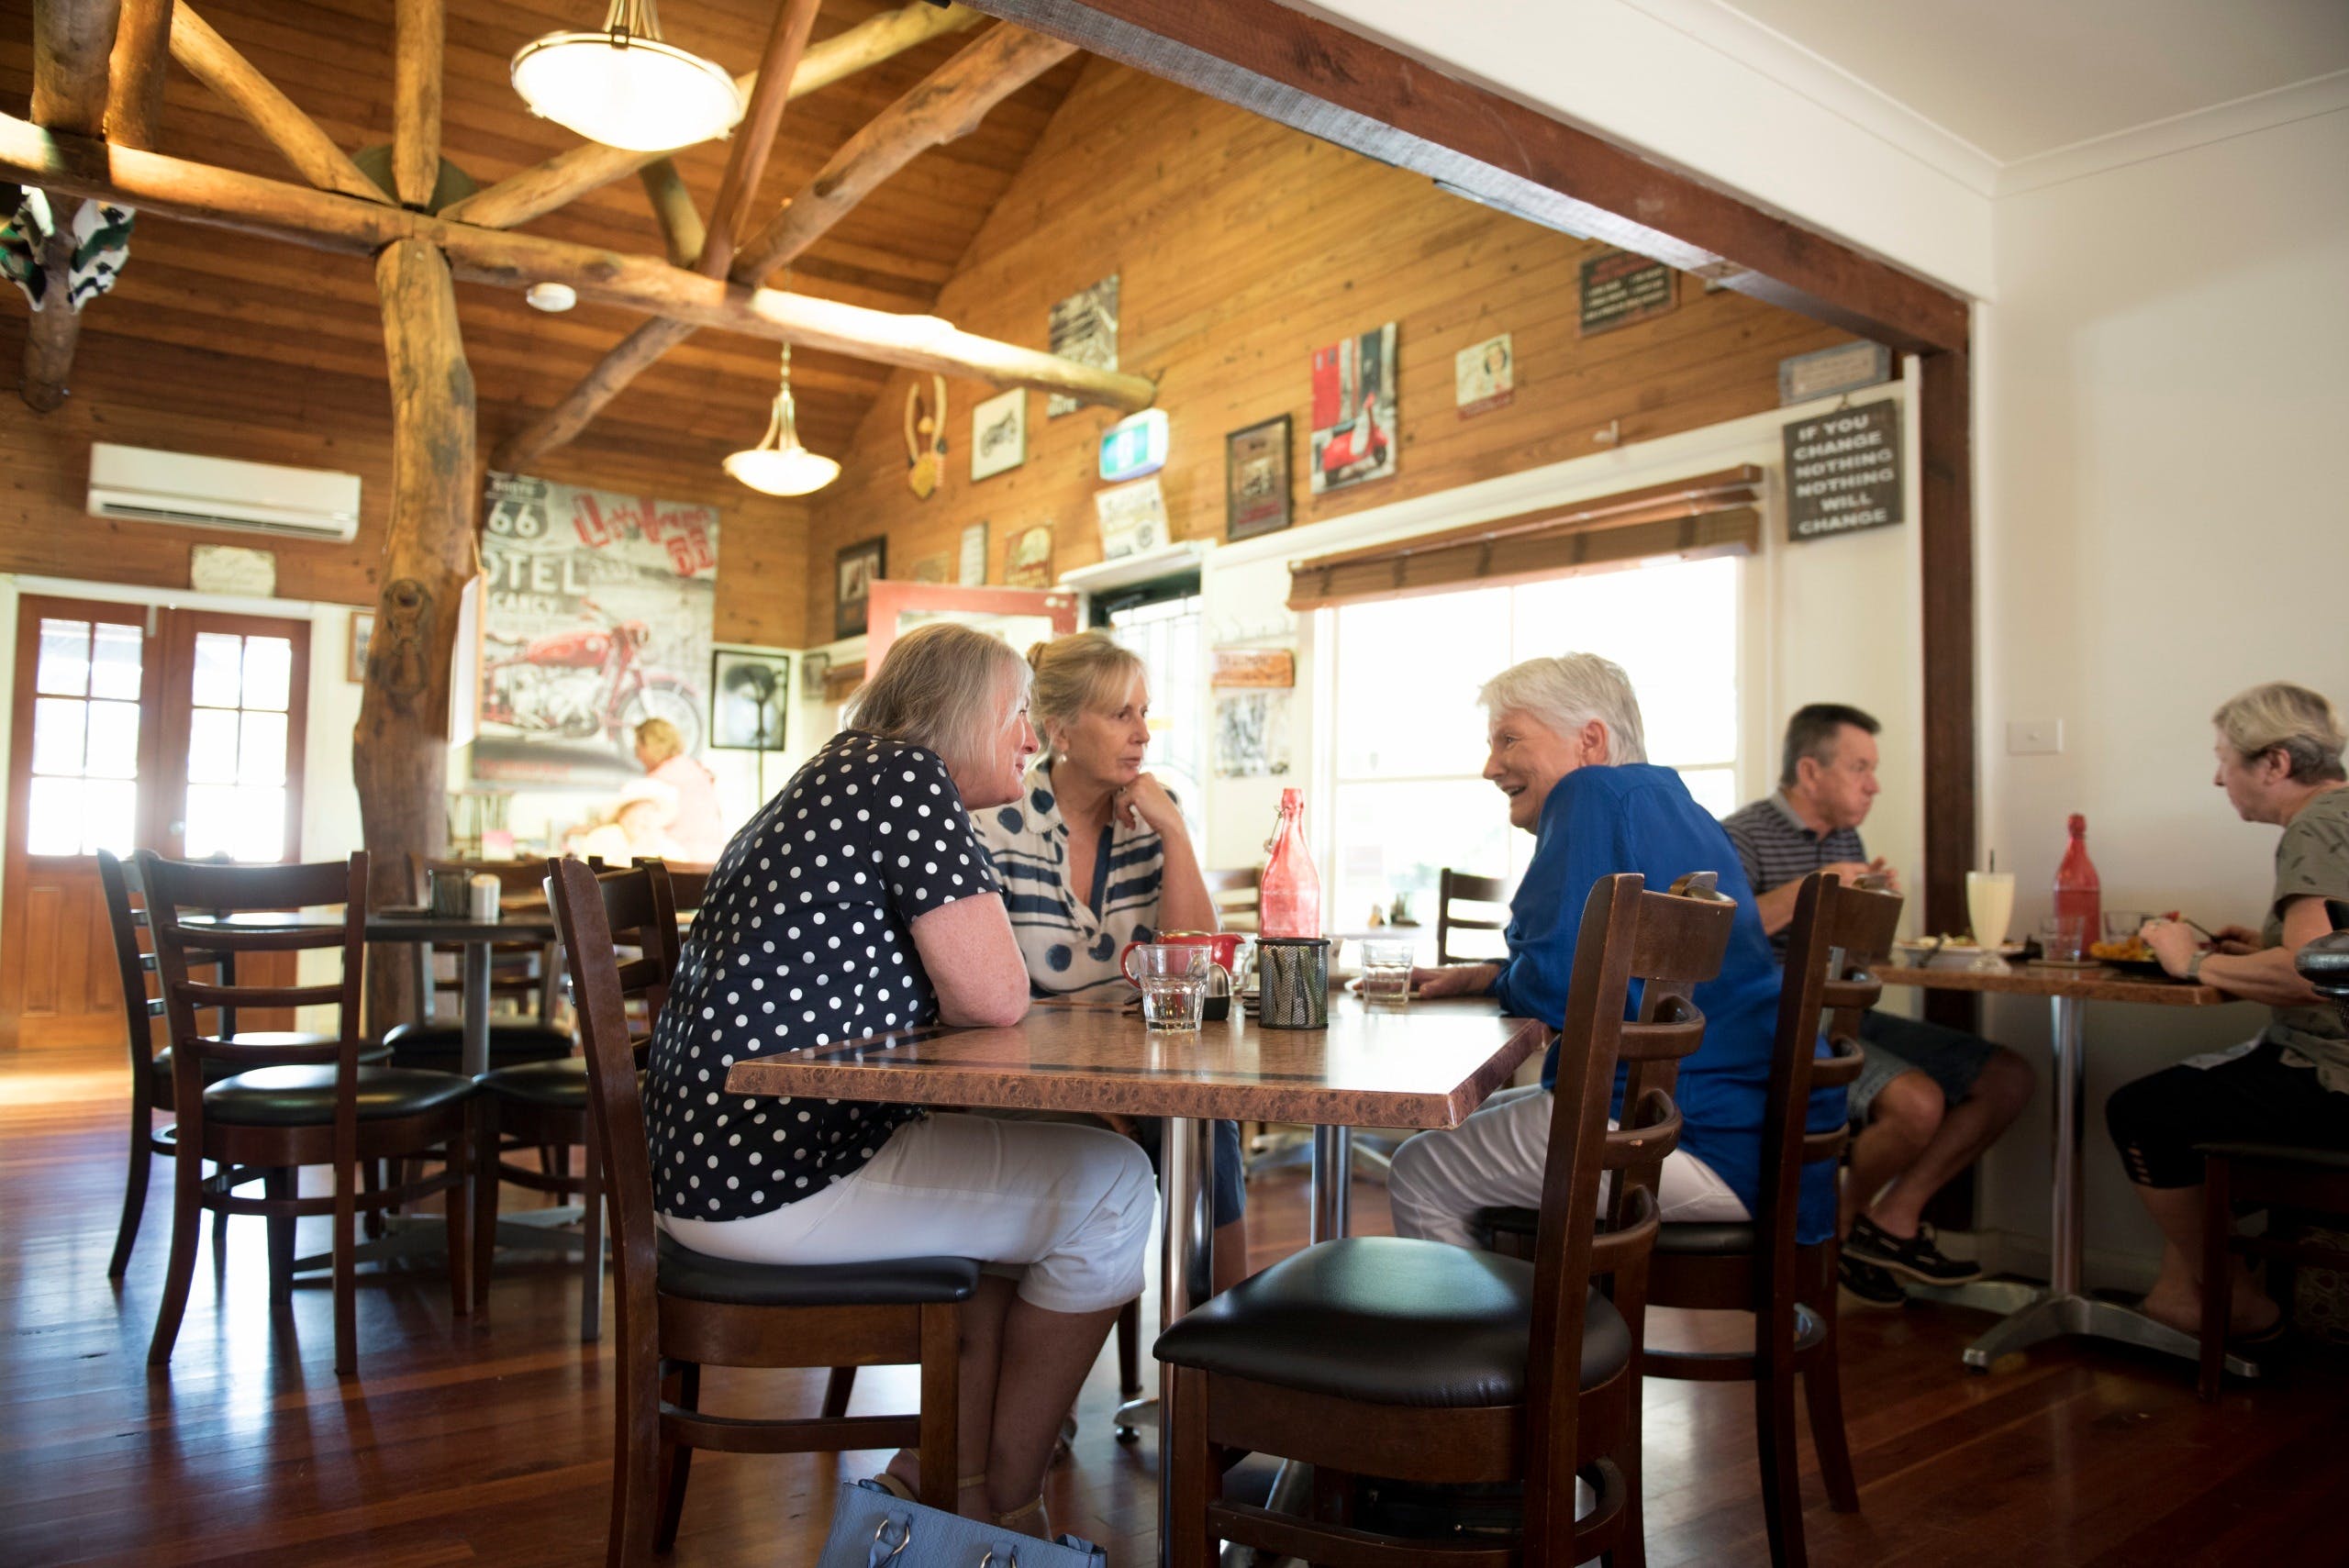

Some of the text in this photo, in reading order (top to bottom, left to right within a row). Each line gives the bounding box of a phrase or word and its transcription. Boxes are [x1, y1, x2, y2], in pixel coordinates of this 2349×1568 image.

[1798, 414, 1869, 442] IF YOU
[1794, 429, 1882, 461] CHANGE
[1795, 448, 1893, 479] NOTHING
[1795, 468, 1894, 498] NOTHING
[1820, 491, 1874, 512] WILL
[488, 499, 540, 539] 66
[1798, 507, 1887, 535] CHANGE
[483, 549, 588, 595] OTEL
